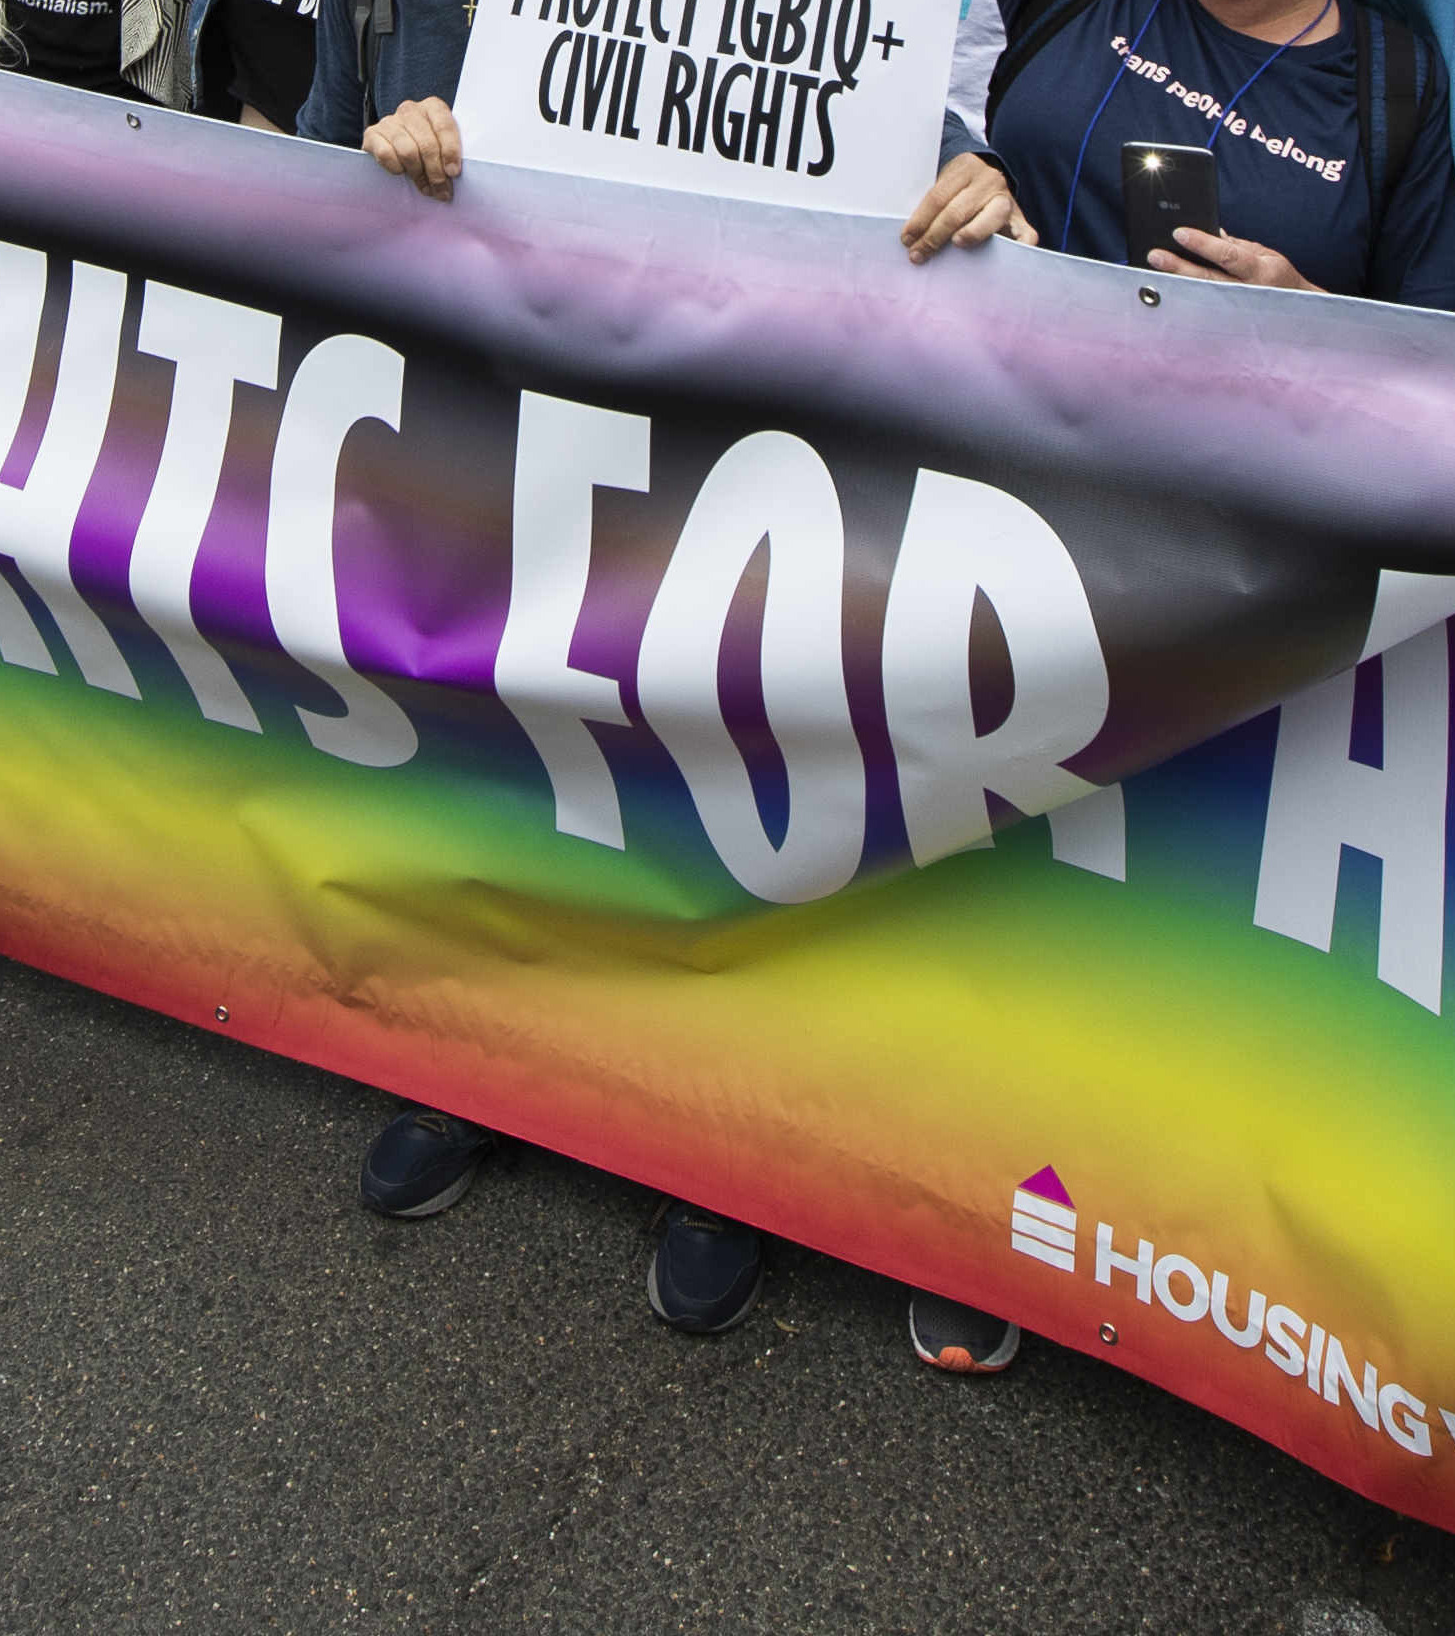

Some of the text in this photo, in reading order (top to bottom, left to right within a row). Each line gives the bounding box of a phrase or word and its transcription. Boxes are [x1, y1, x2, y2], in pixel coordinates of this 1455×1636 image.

[538, 30, 854, 178] CIVIL RIGHTS
[1110, 35, 1346, 182] trans people belong
[494, 386, 1129, 905] FOR
[1094, 1221, 1434, 1459] HOUSING
